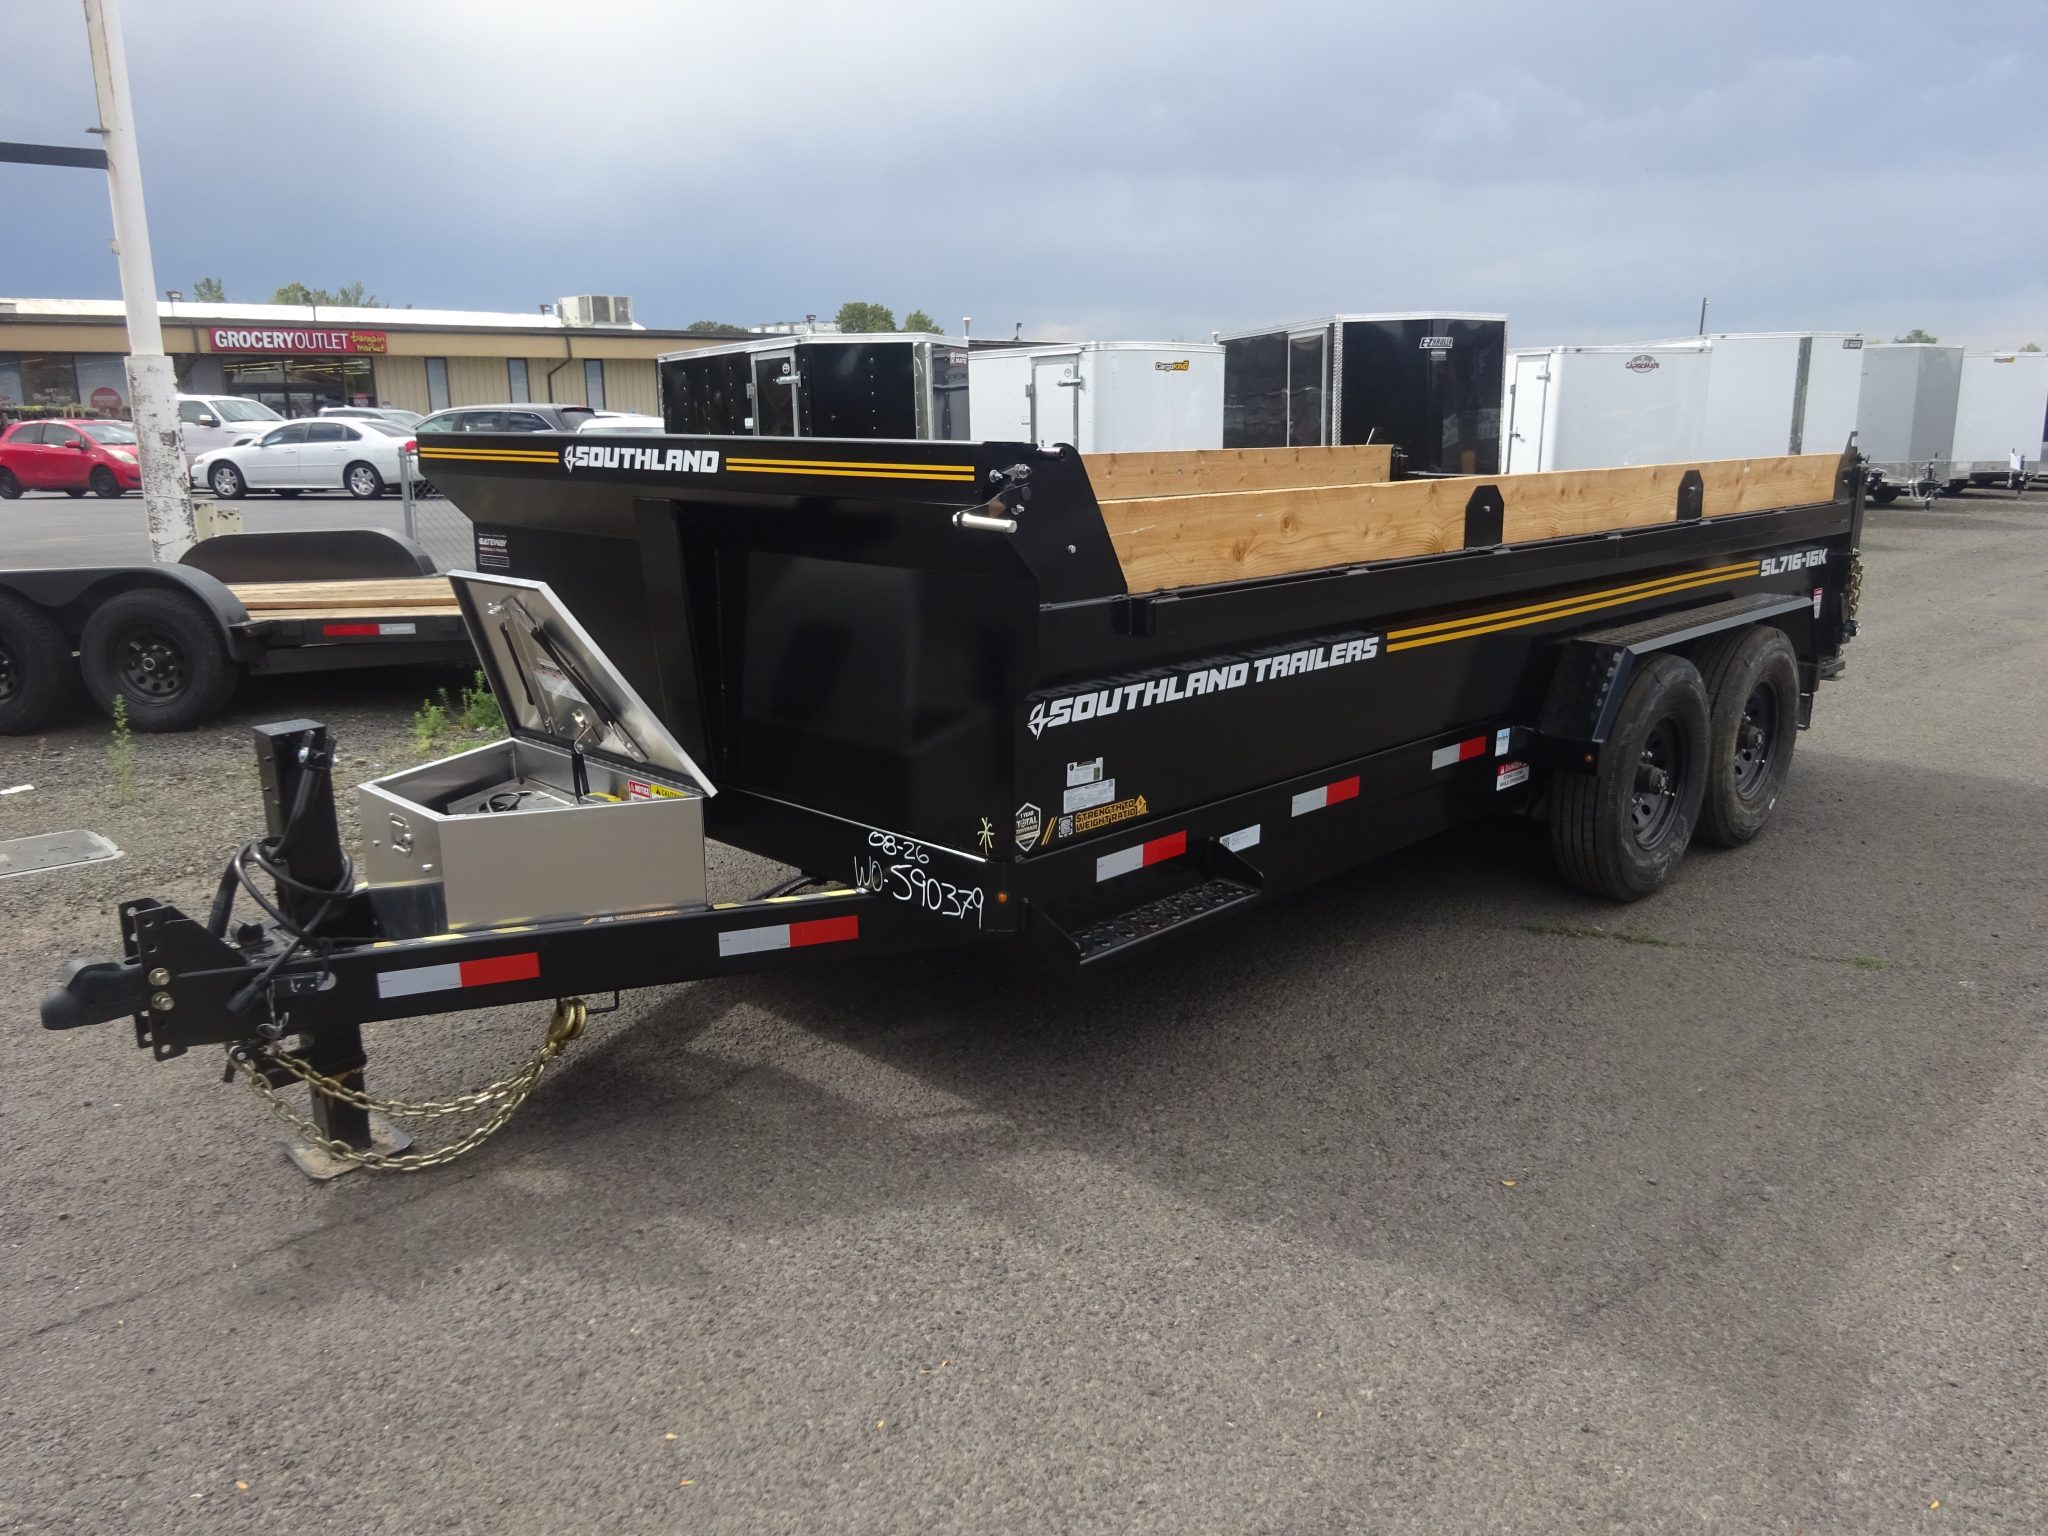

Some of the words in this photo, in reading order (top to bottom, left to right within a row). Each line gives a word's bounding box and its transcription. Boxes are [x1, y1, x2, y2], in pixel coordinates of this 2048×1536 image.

[350, 331, 385, 346] bargain
[356, 343, 385, 352] market
[575, 446, 720, 474] SOUTHLAND
[1760, 548, 1828, 577] SL716-16K
[1047, 662, 1249, 727] SOUTHLAND
[1253, 637, 1379, 682] TRAILERS
[1016, 816, 1038, 828] TOTAL
[1023, 810, 1034, 818] YEAR
[1076, 803, 1122, 823] STRENGTH
[1122, 800, 1134, 810] TO
[1076, 815, 1110, 832] WEIGHT
[1111, 808, 1136, 821] RATIO
[868, 831, 930, 864] 08-26
